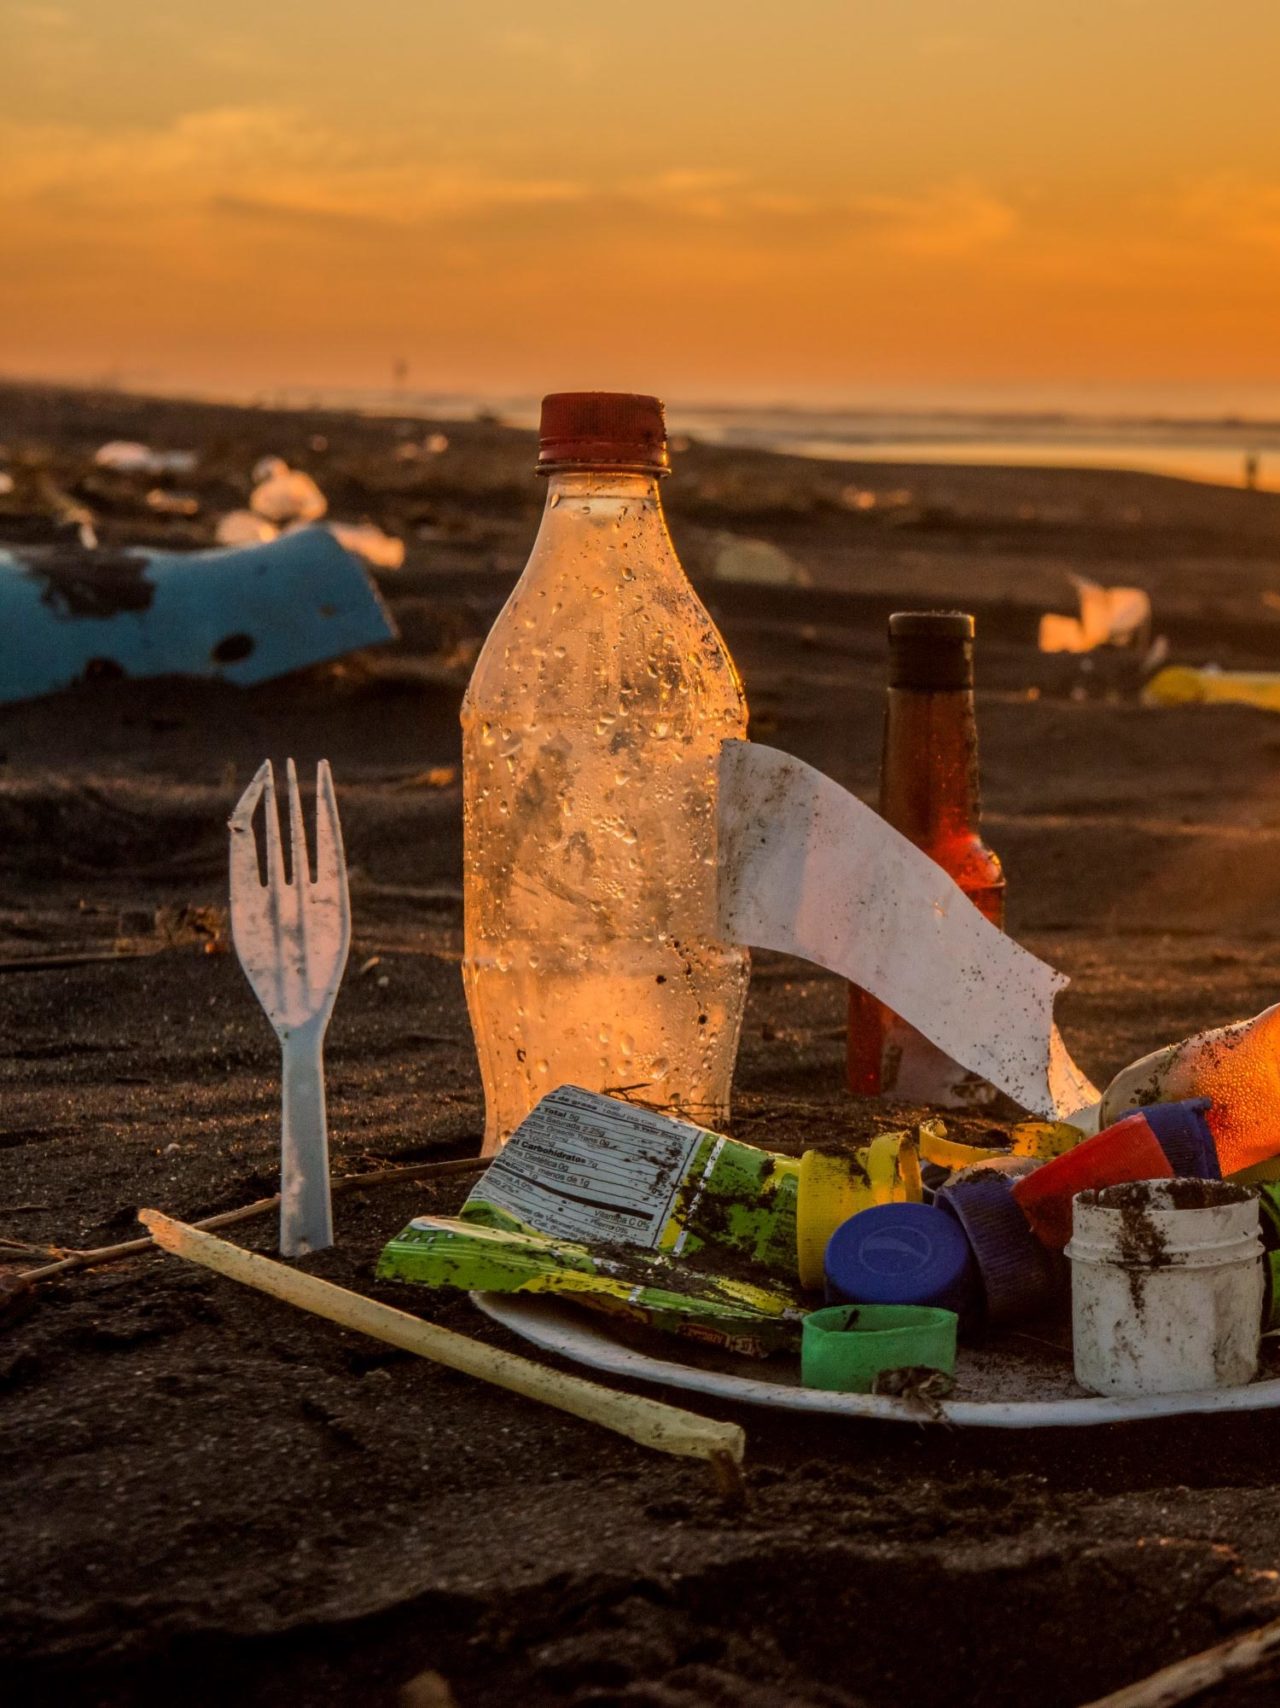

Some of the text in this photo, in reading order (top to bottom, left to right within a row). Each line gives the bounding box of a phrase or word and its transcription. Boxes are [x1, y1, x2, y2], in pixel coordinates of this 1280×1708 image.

[544, 1107, 566, 1118] Total
[546, 1116, 580, 1130] Saturada
[521, 1140, 587, 1163] Carbohidratos
[594, 1209, 627, 1225] Vitamina
